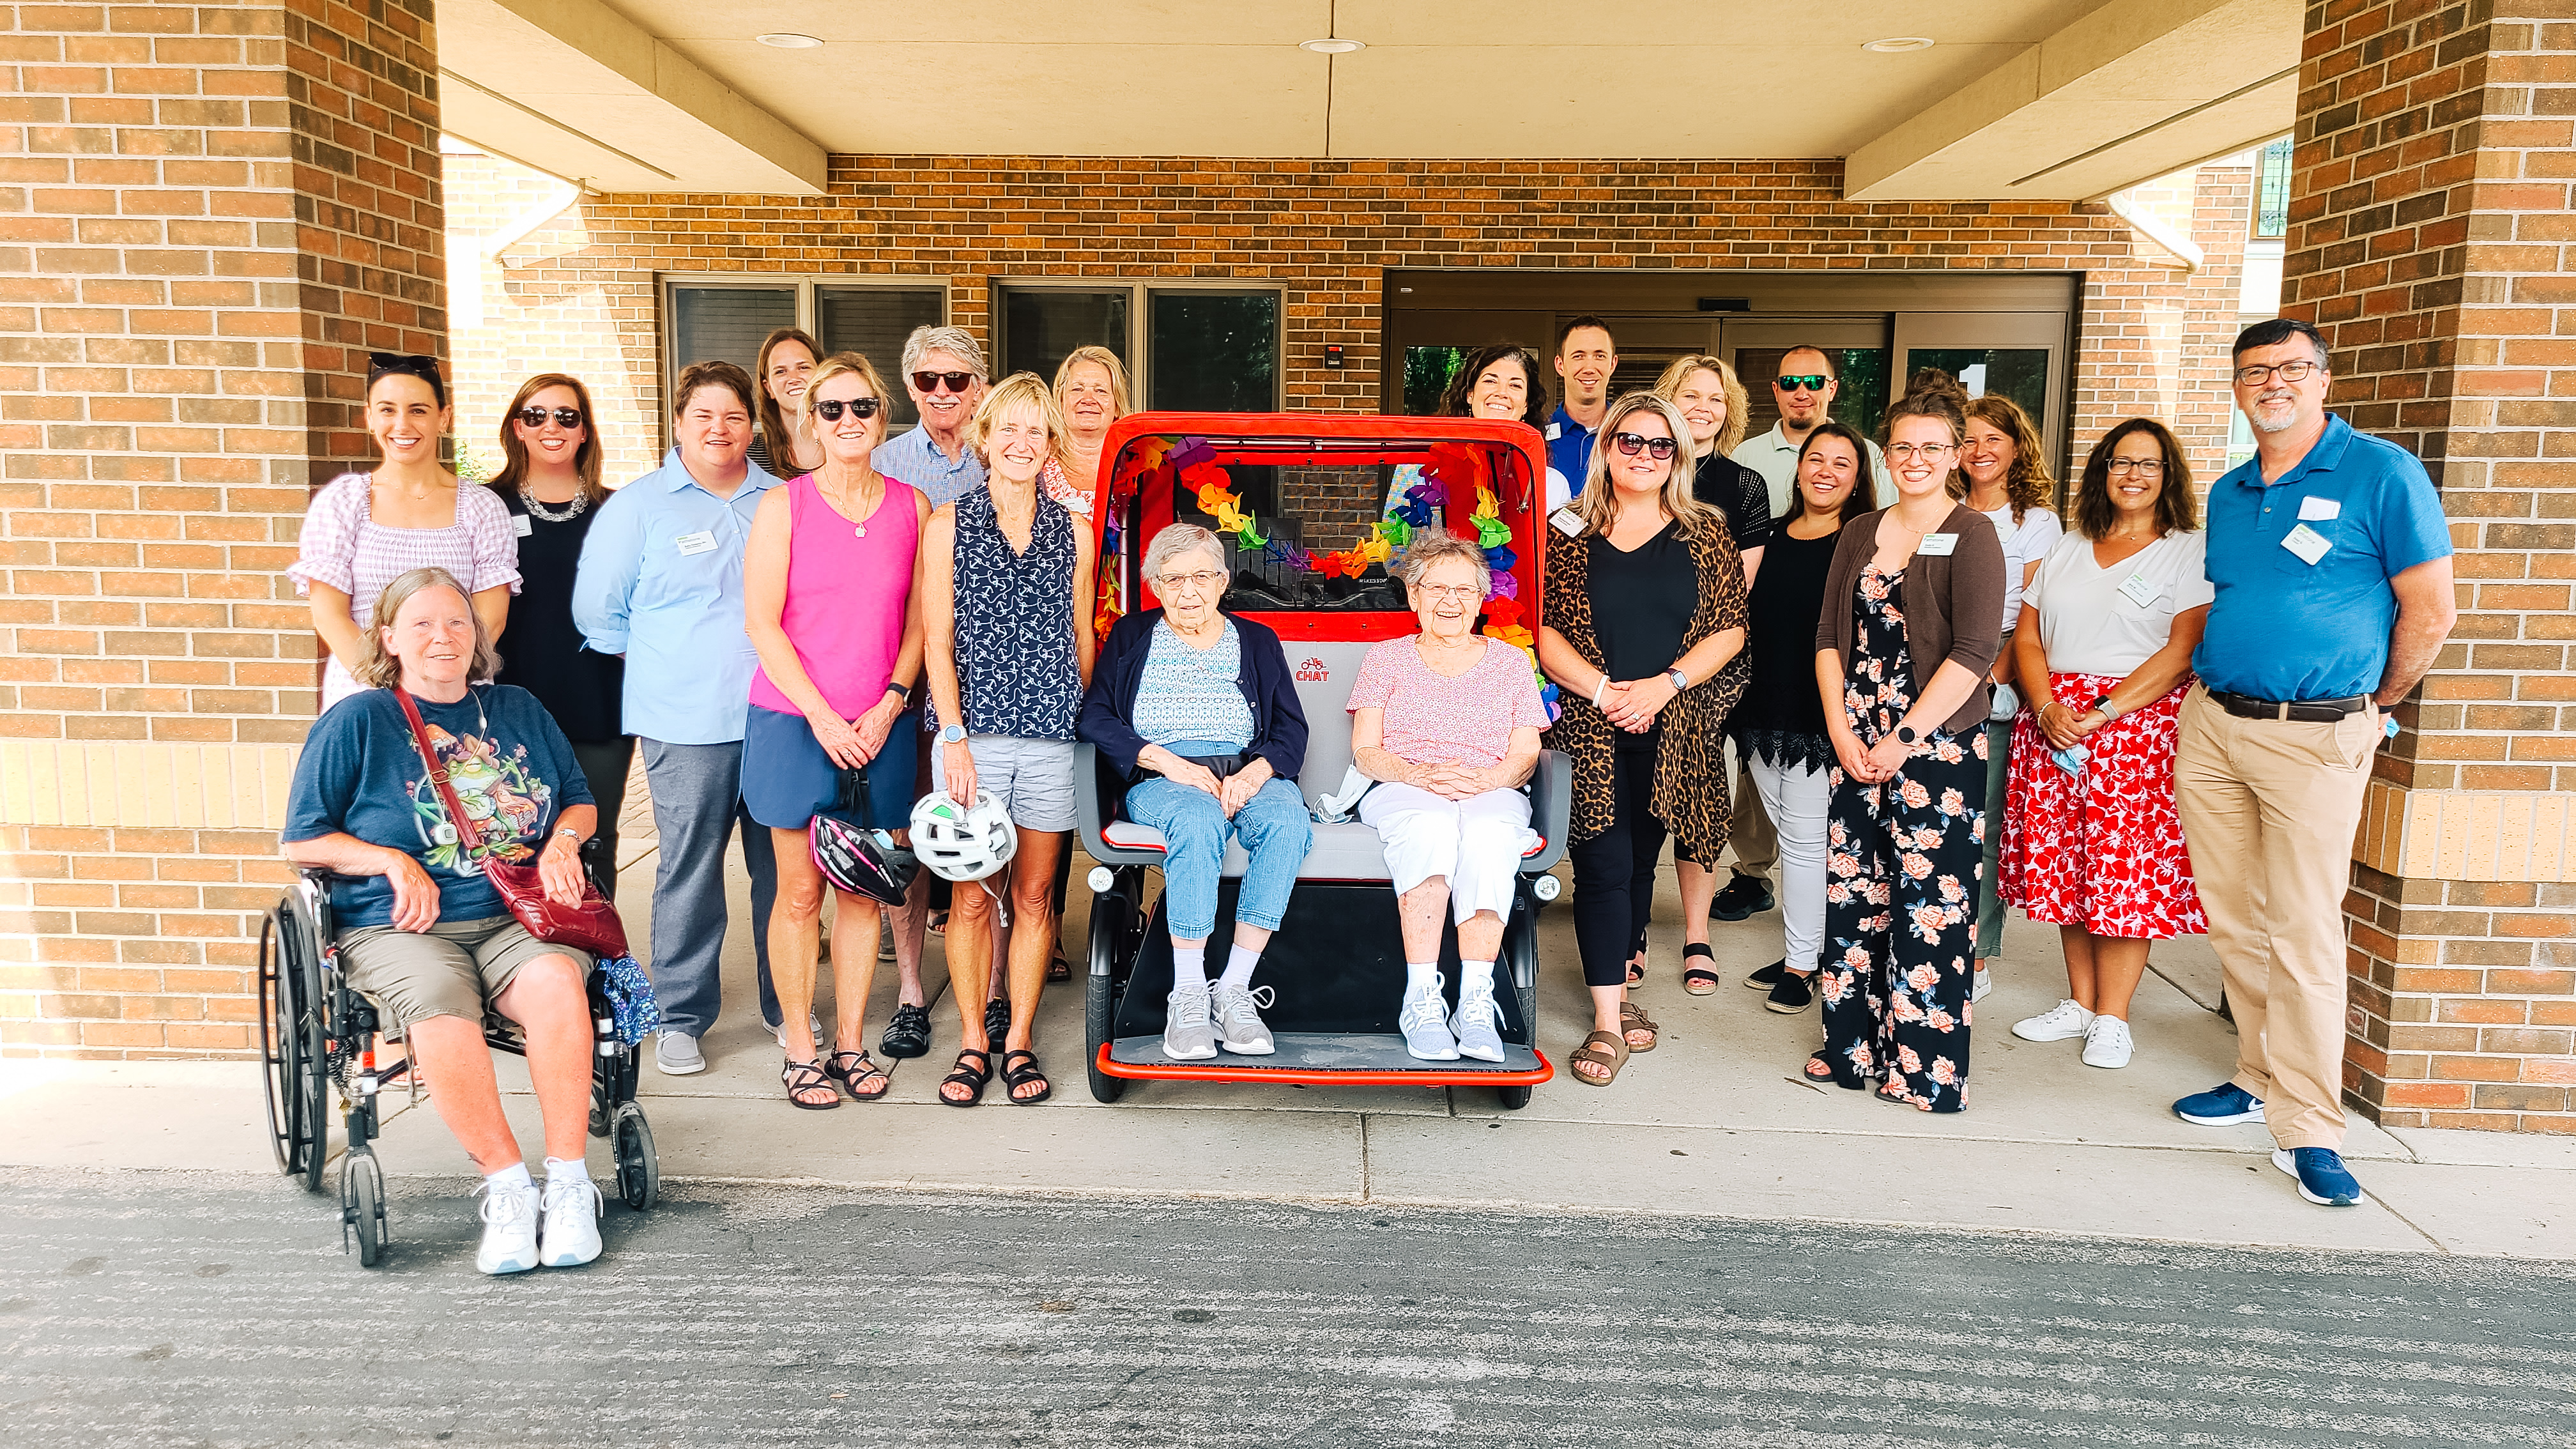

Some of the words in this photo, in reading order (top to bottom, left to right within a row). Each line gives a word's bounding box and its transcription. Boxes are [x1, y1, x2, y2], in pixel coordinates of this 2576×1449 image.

[1959, 364, 1986, 401] 1
[1296, 670, 1329, 682] CHAT
[940, 796, 958, 808] SMITH
